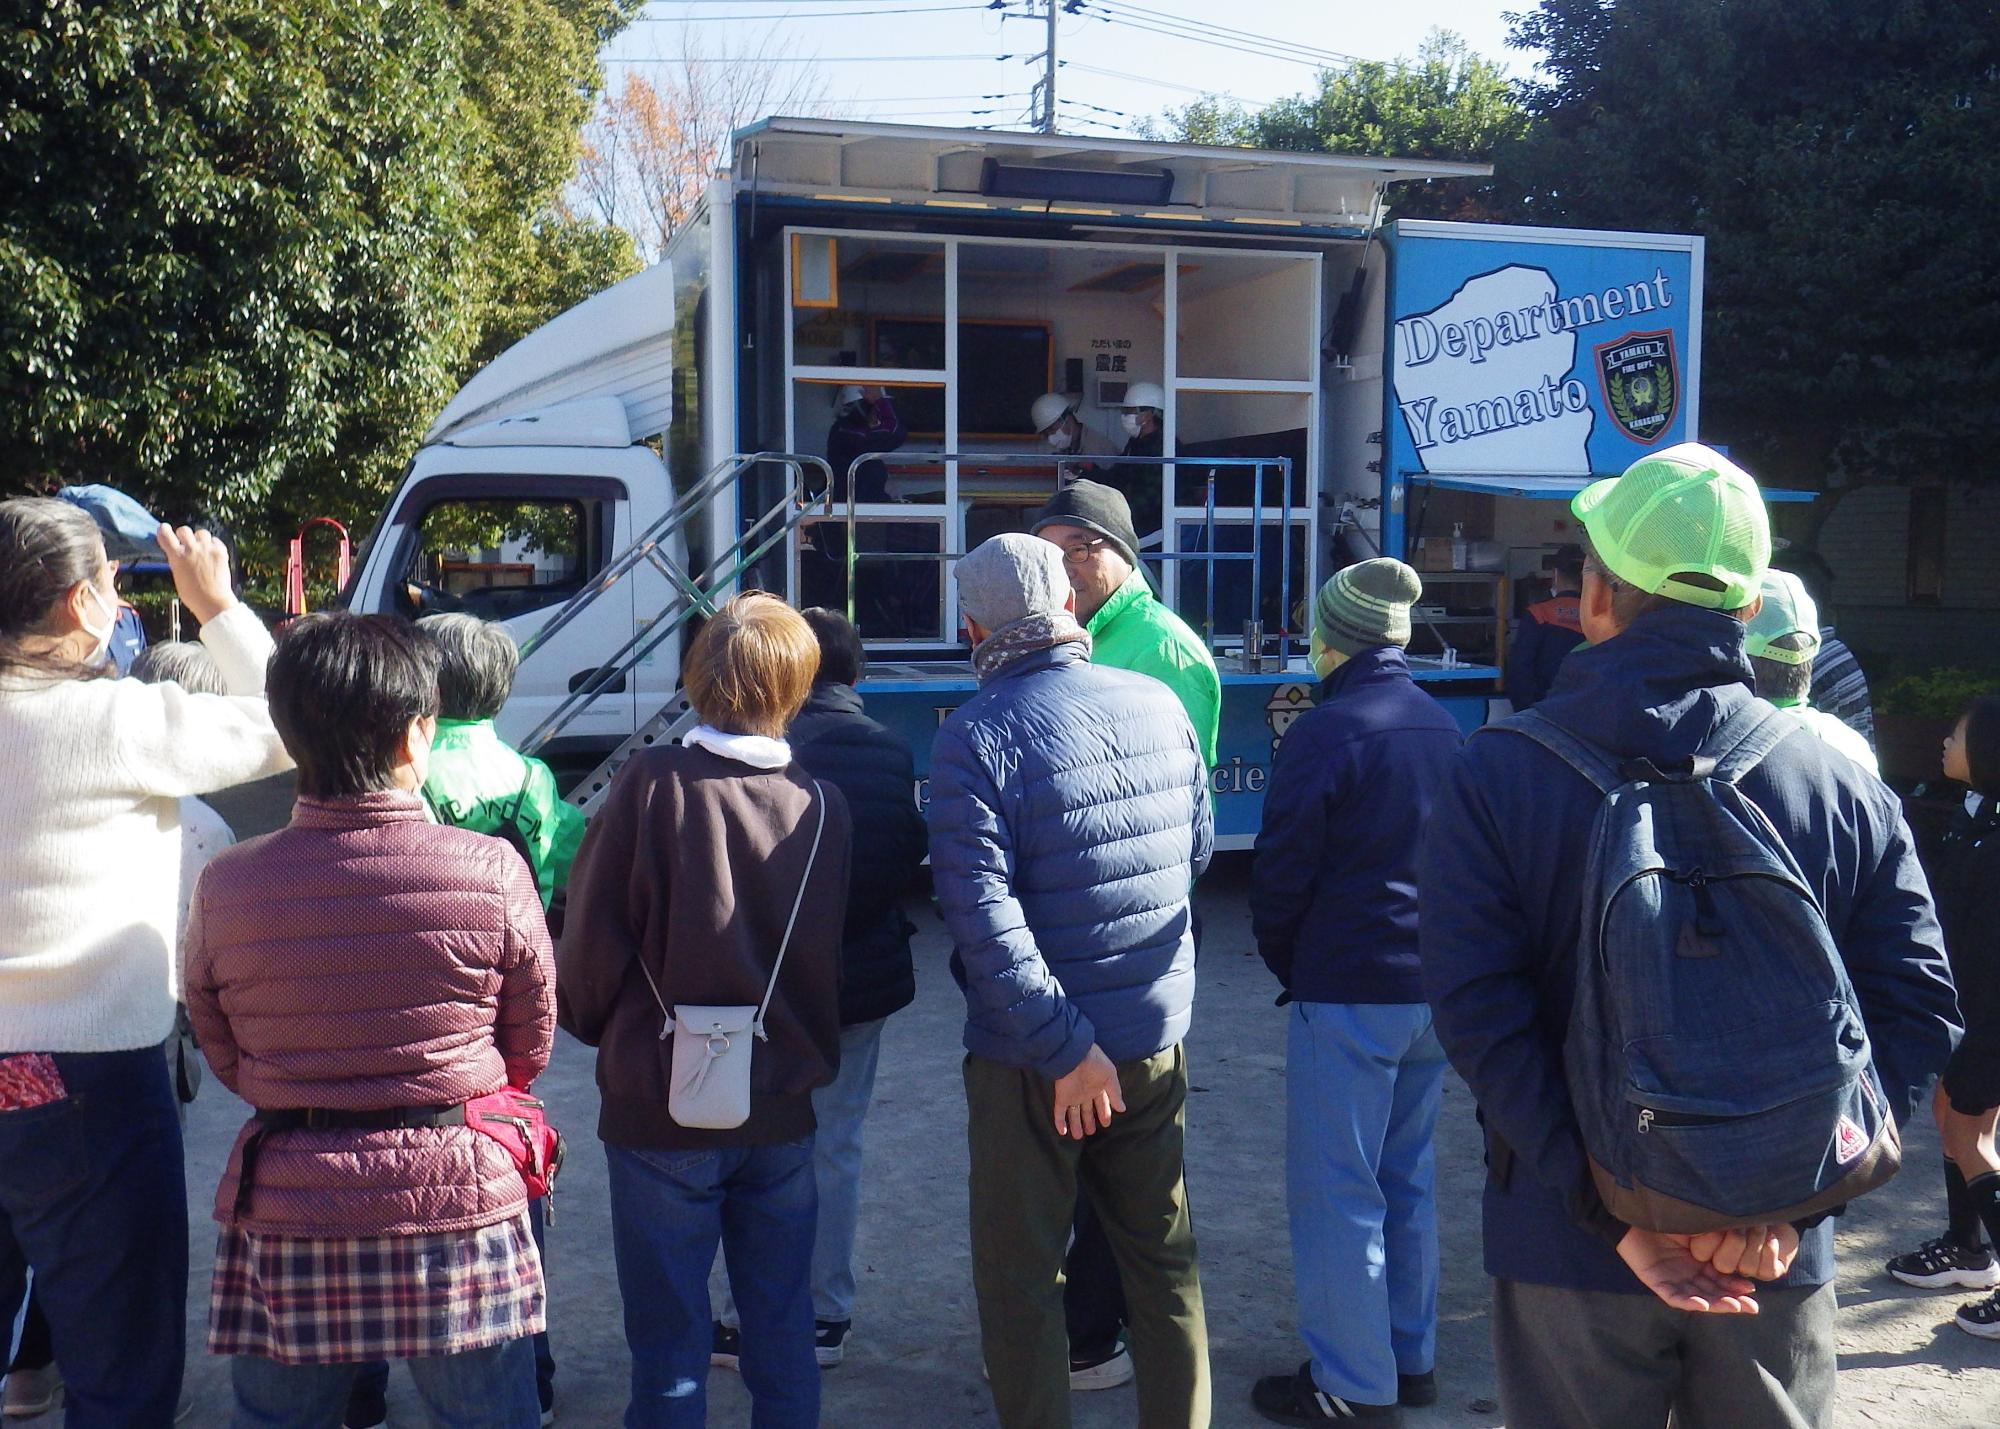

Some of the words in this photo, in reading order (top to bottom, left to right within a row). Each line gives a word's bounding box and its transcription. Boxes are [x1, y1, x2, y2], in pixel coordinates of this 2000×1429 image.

[1400, 267, 1673, 367] Department
[1095, 353, 1127, 373] 震度
[1620, 344, 1651, 360] YAMATO
[1399, 374, 1588, 449] Yamato
[1210, 757, 1265, 793] cle
